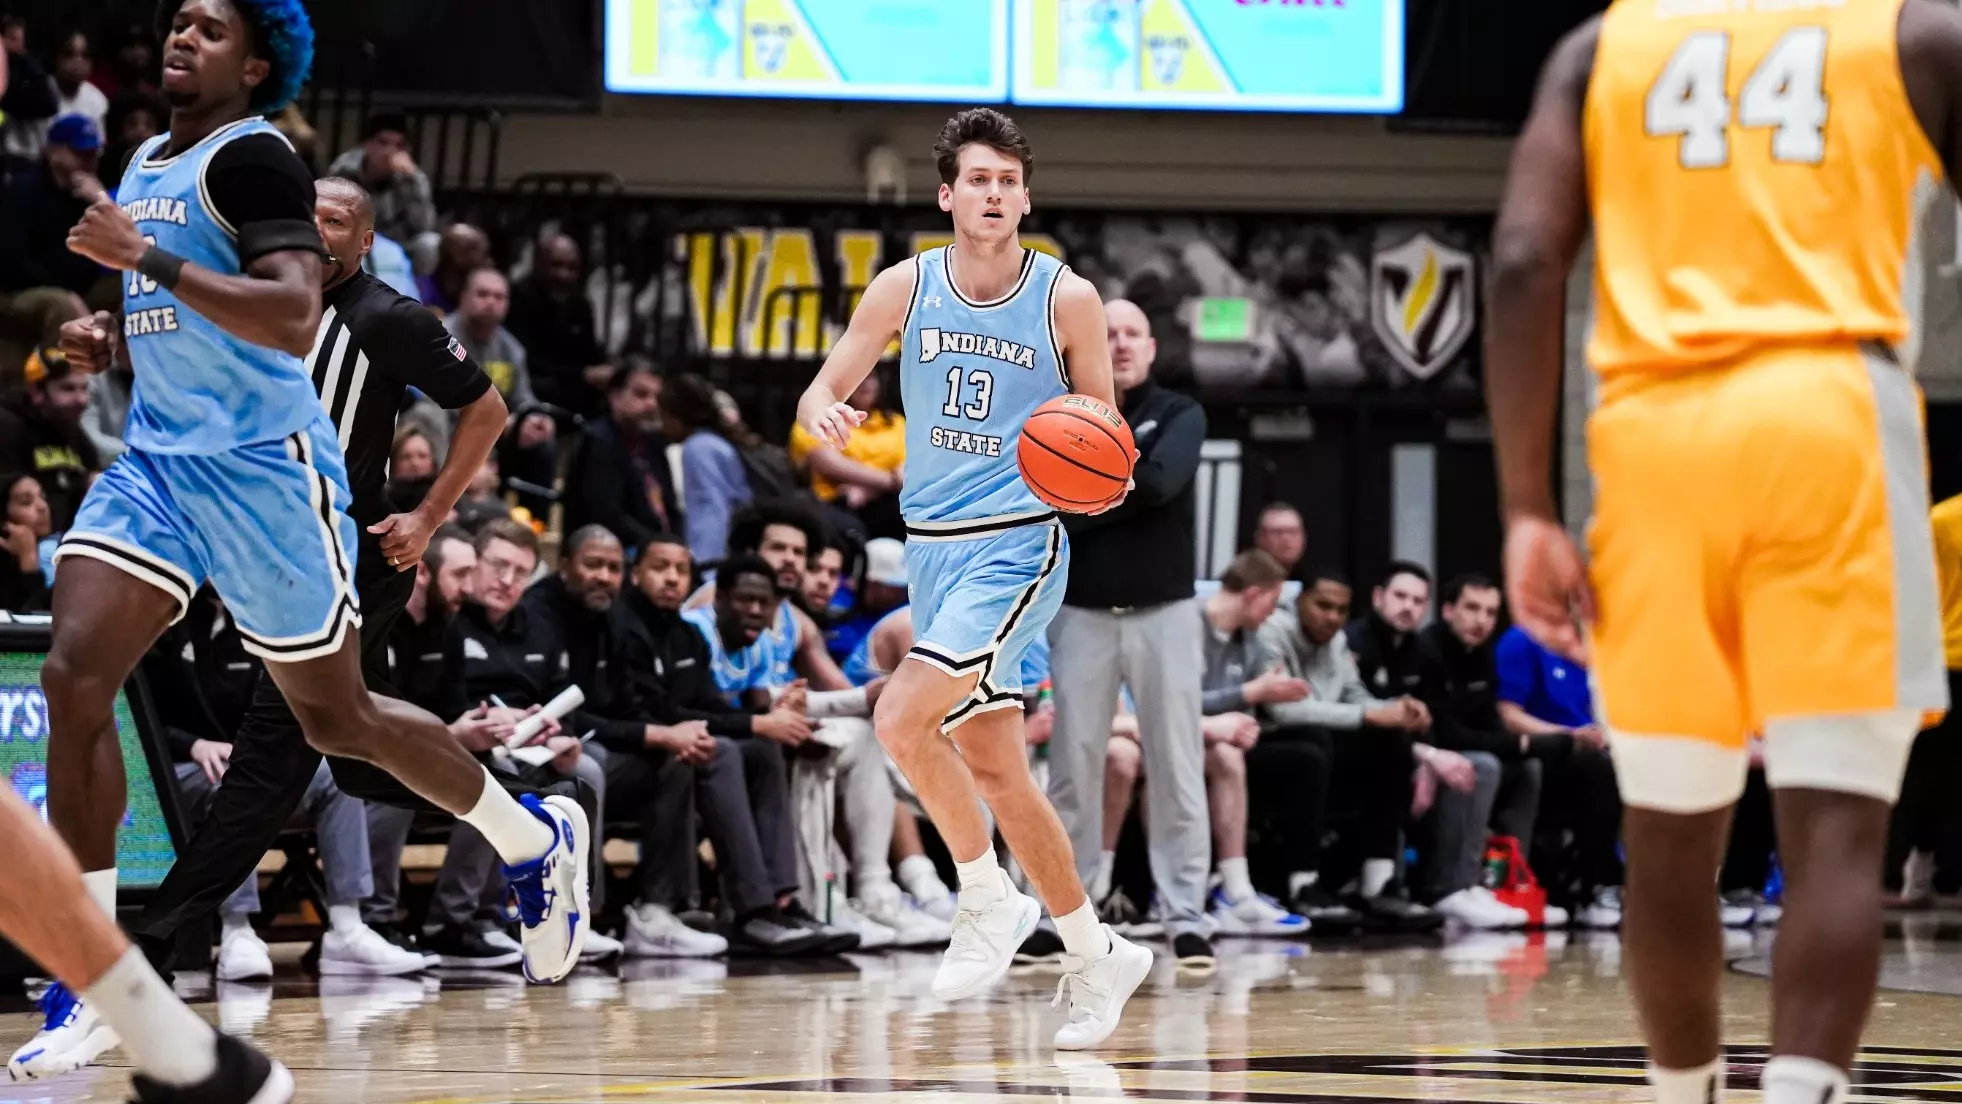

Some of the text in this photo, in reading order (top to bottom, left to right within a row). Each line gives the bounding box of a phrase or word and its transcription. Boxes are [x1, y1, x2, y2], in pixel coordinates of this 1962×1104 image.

[1644, 26, 1830, 169] 44
[125, 305, 180, 337] STATE
[942, 365, 994, 421] 13
[931, 426, 1002, 457] STATE
